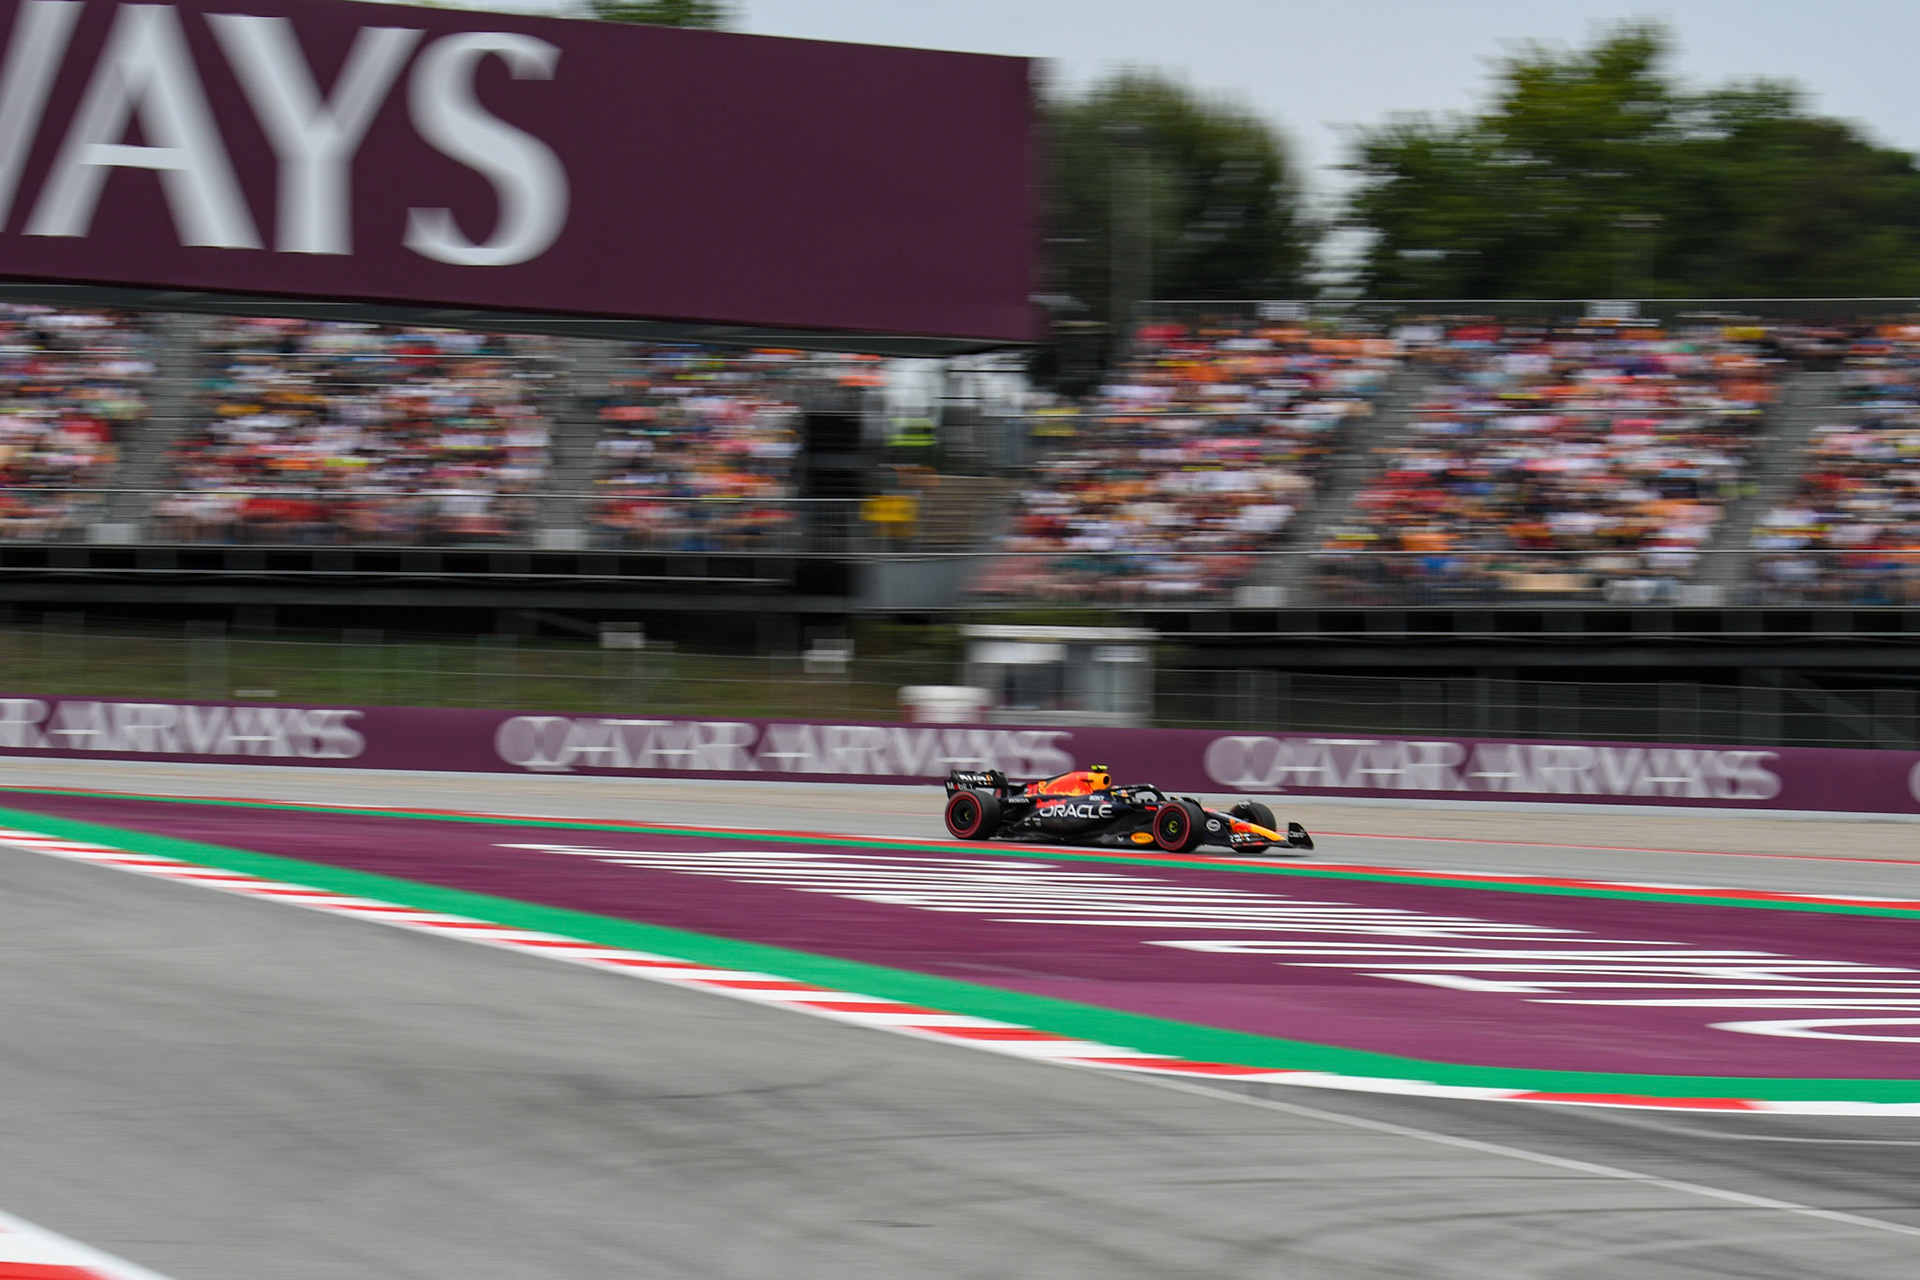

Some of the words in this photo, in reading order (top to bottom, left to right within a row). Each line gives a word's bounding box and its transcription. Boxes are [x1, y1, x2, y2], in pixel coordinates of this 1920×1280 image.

[494, 716, 762, 771] QATAR
[1203, 735, 1468, 791] QATAR
[1040, 804, 1114, 819] ORACLE
